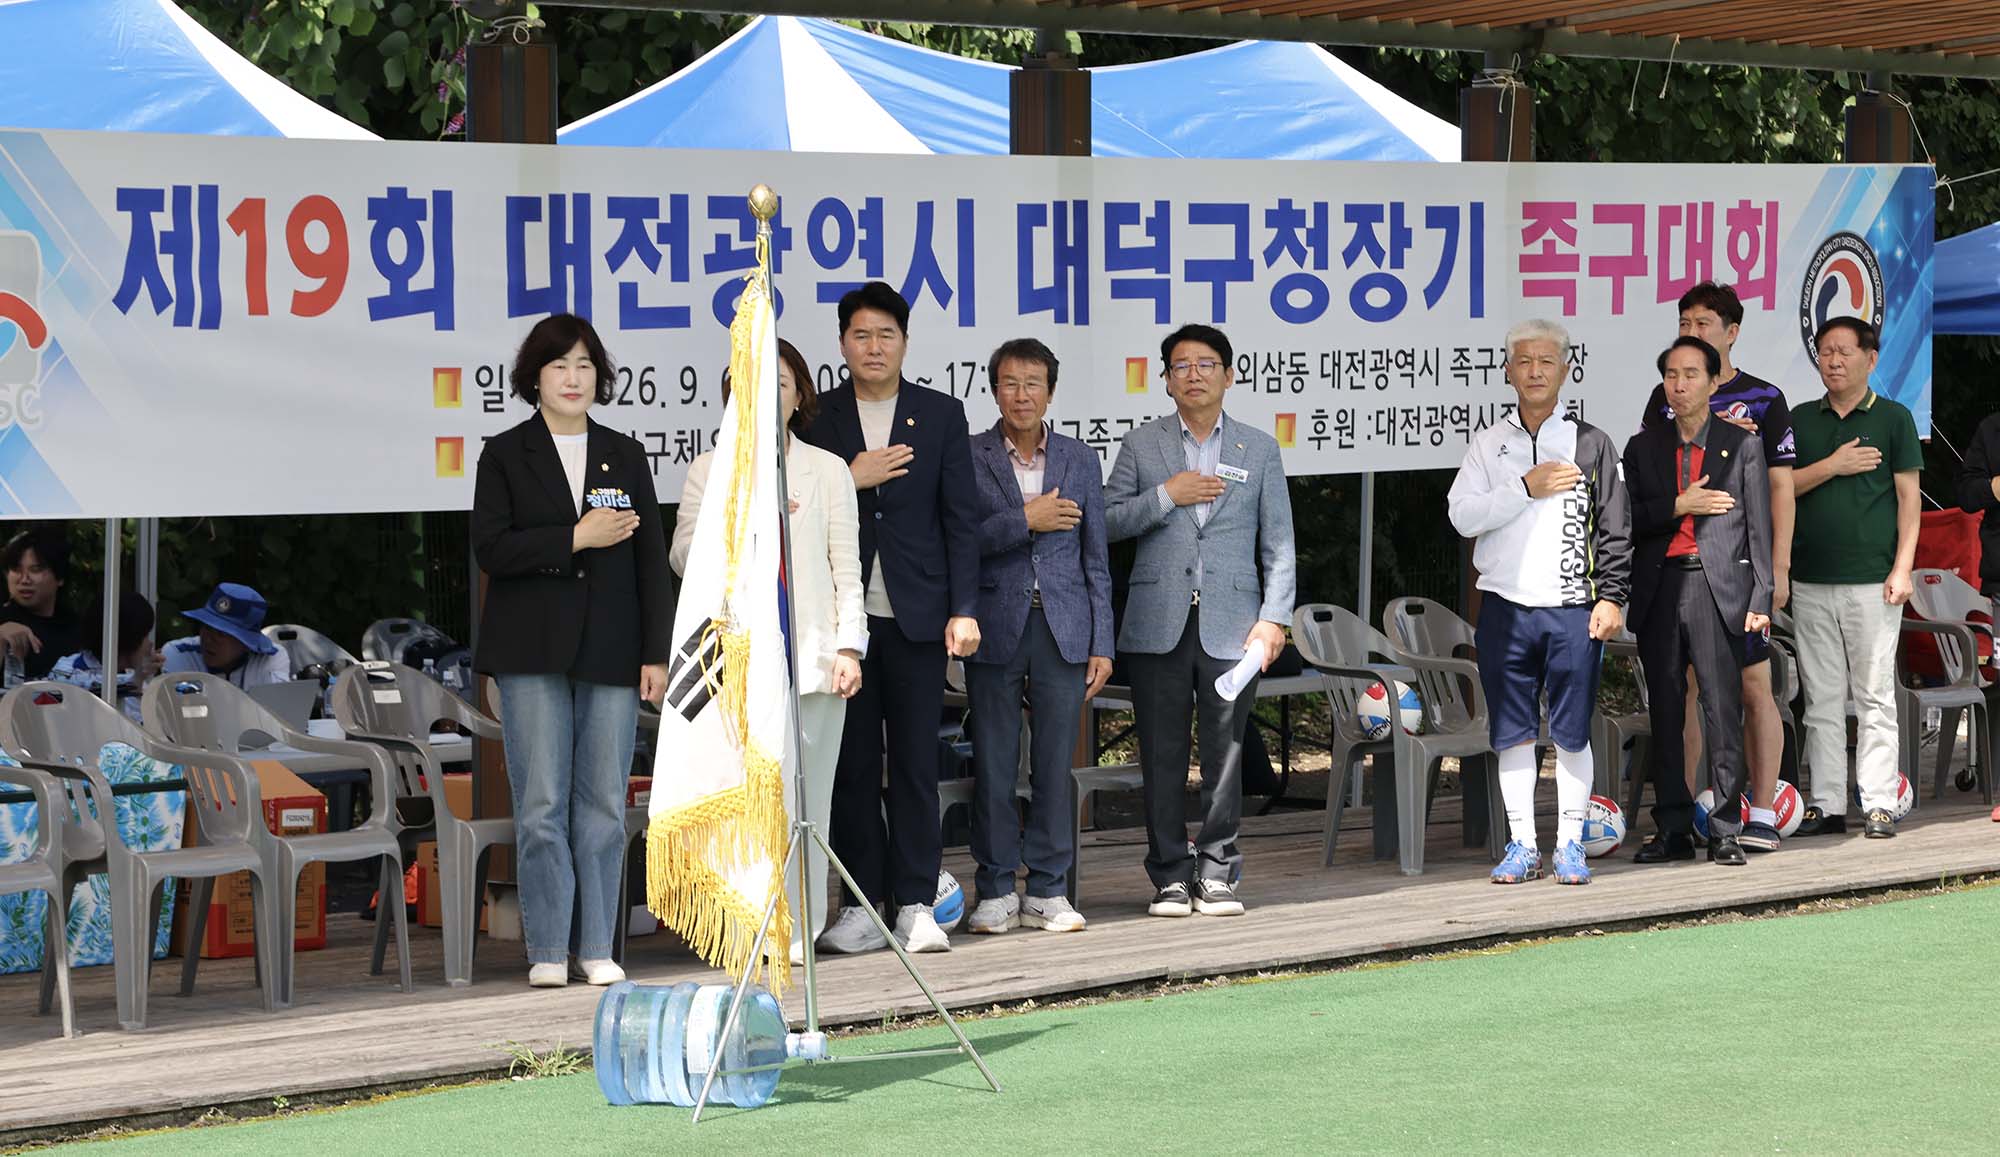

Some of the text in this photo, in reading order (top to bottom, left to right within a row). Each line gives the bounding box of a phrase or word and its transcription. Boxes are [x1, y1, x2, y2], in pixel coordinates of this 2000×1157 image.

[112, 184, 1780, 331] 제19회 대전광역시 대덕구청장기 족구대회
[945, 361, 987, 398] 17:
[1235, 349, 1310, 394] 외삼동
[1320, 345, 1441, 391] 대전광역시
[1308, 407, 1356, 451] 후원
[1560, 476, 1589, 606] YEJOKSAN
